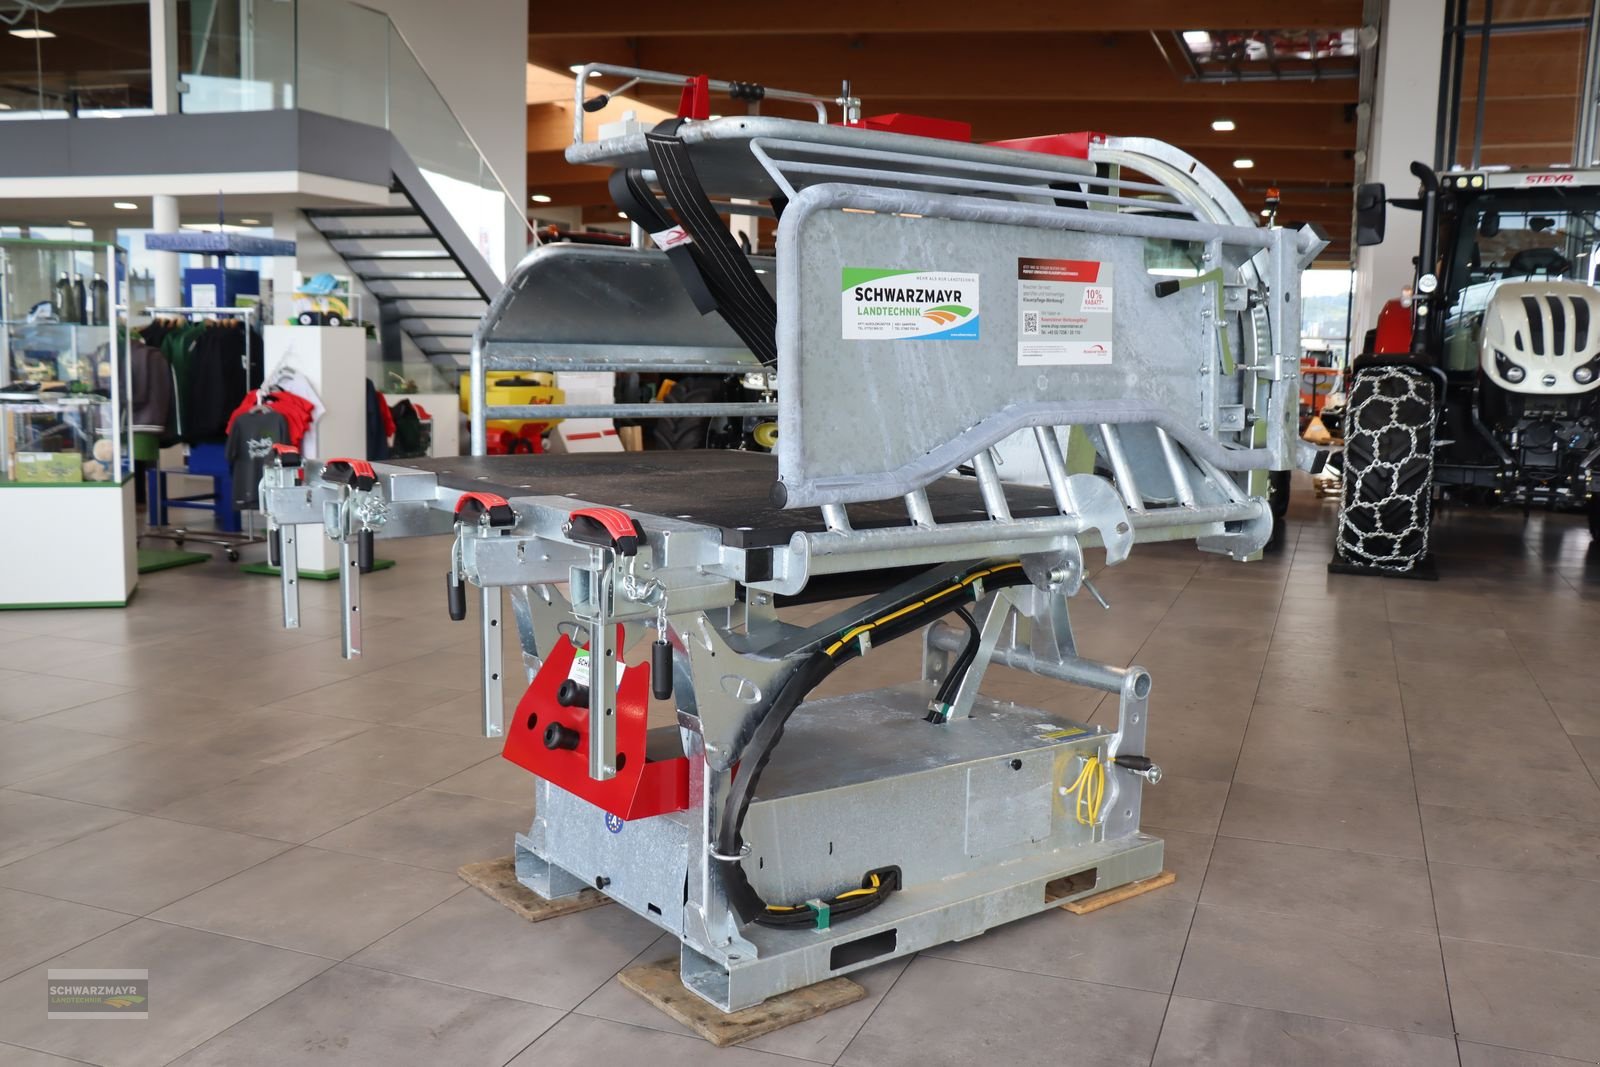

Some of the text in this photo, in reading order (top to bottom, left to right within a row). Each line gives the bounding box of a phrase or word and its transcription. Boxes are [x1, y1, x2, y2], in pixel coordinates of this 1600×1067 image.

[1525, 174, 1574, 184] STEYR
[855, 287, 962, 303] SCHWARZMAYR
[1086, 289, 1102, 300] 10%
[857, 306, 921, 317] LANDTECHNIK
